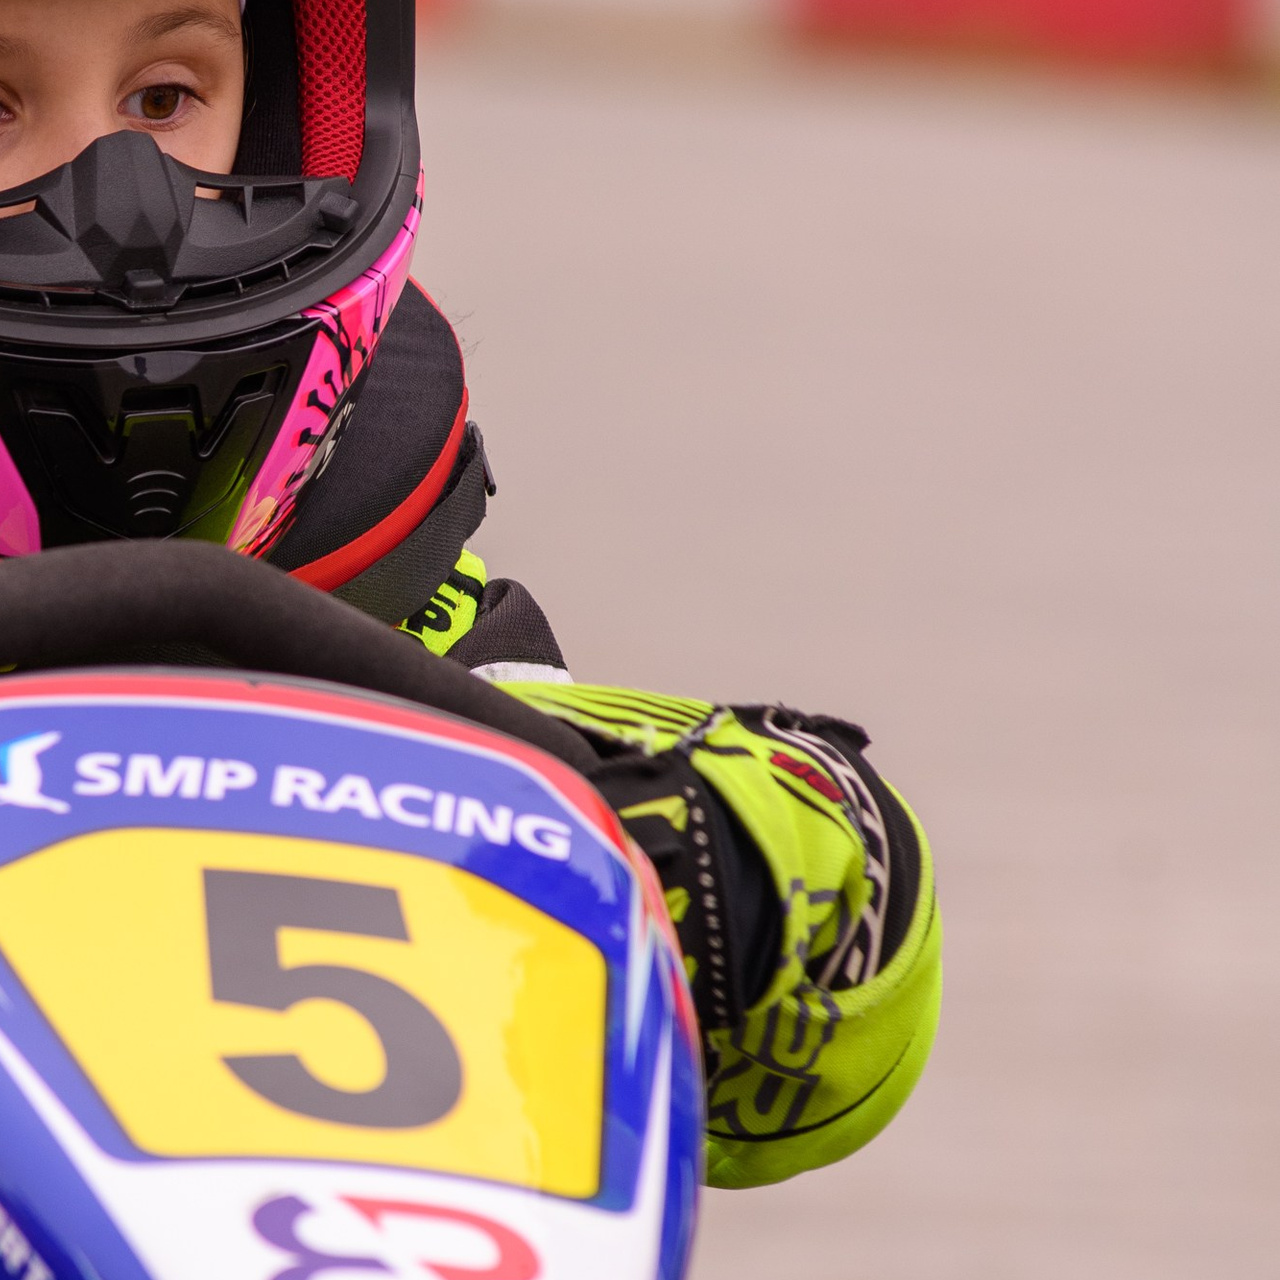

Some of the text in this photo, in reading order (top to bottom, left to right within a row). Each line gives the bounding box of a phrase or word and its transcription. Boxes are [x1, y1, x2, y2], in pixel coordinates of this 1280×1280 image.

[74, 753, 573, 861] SMP RACING
[202, 867, 463, 1129] 5
